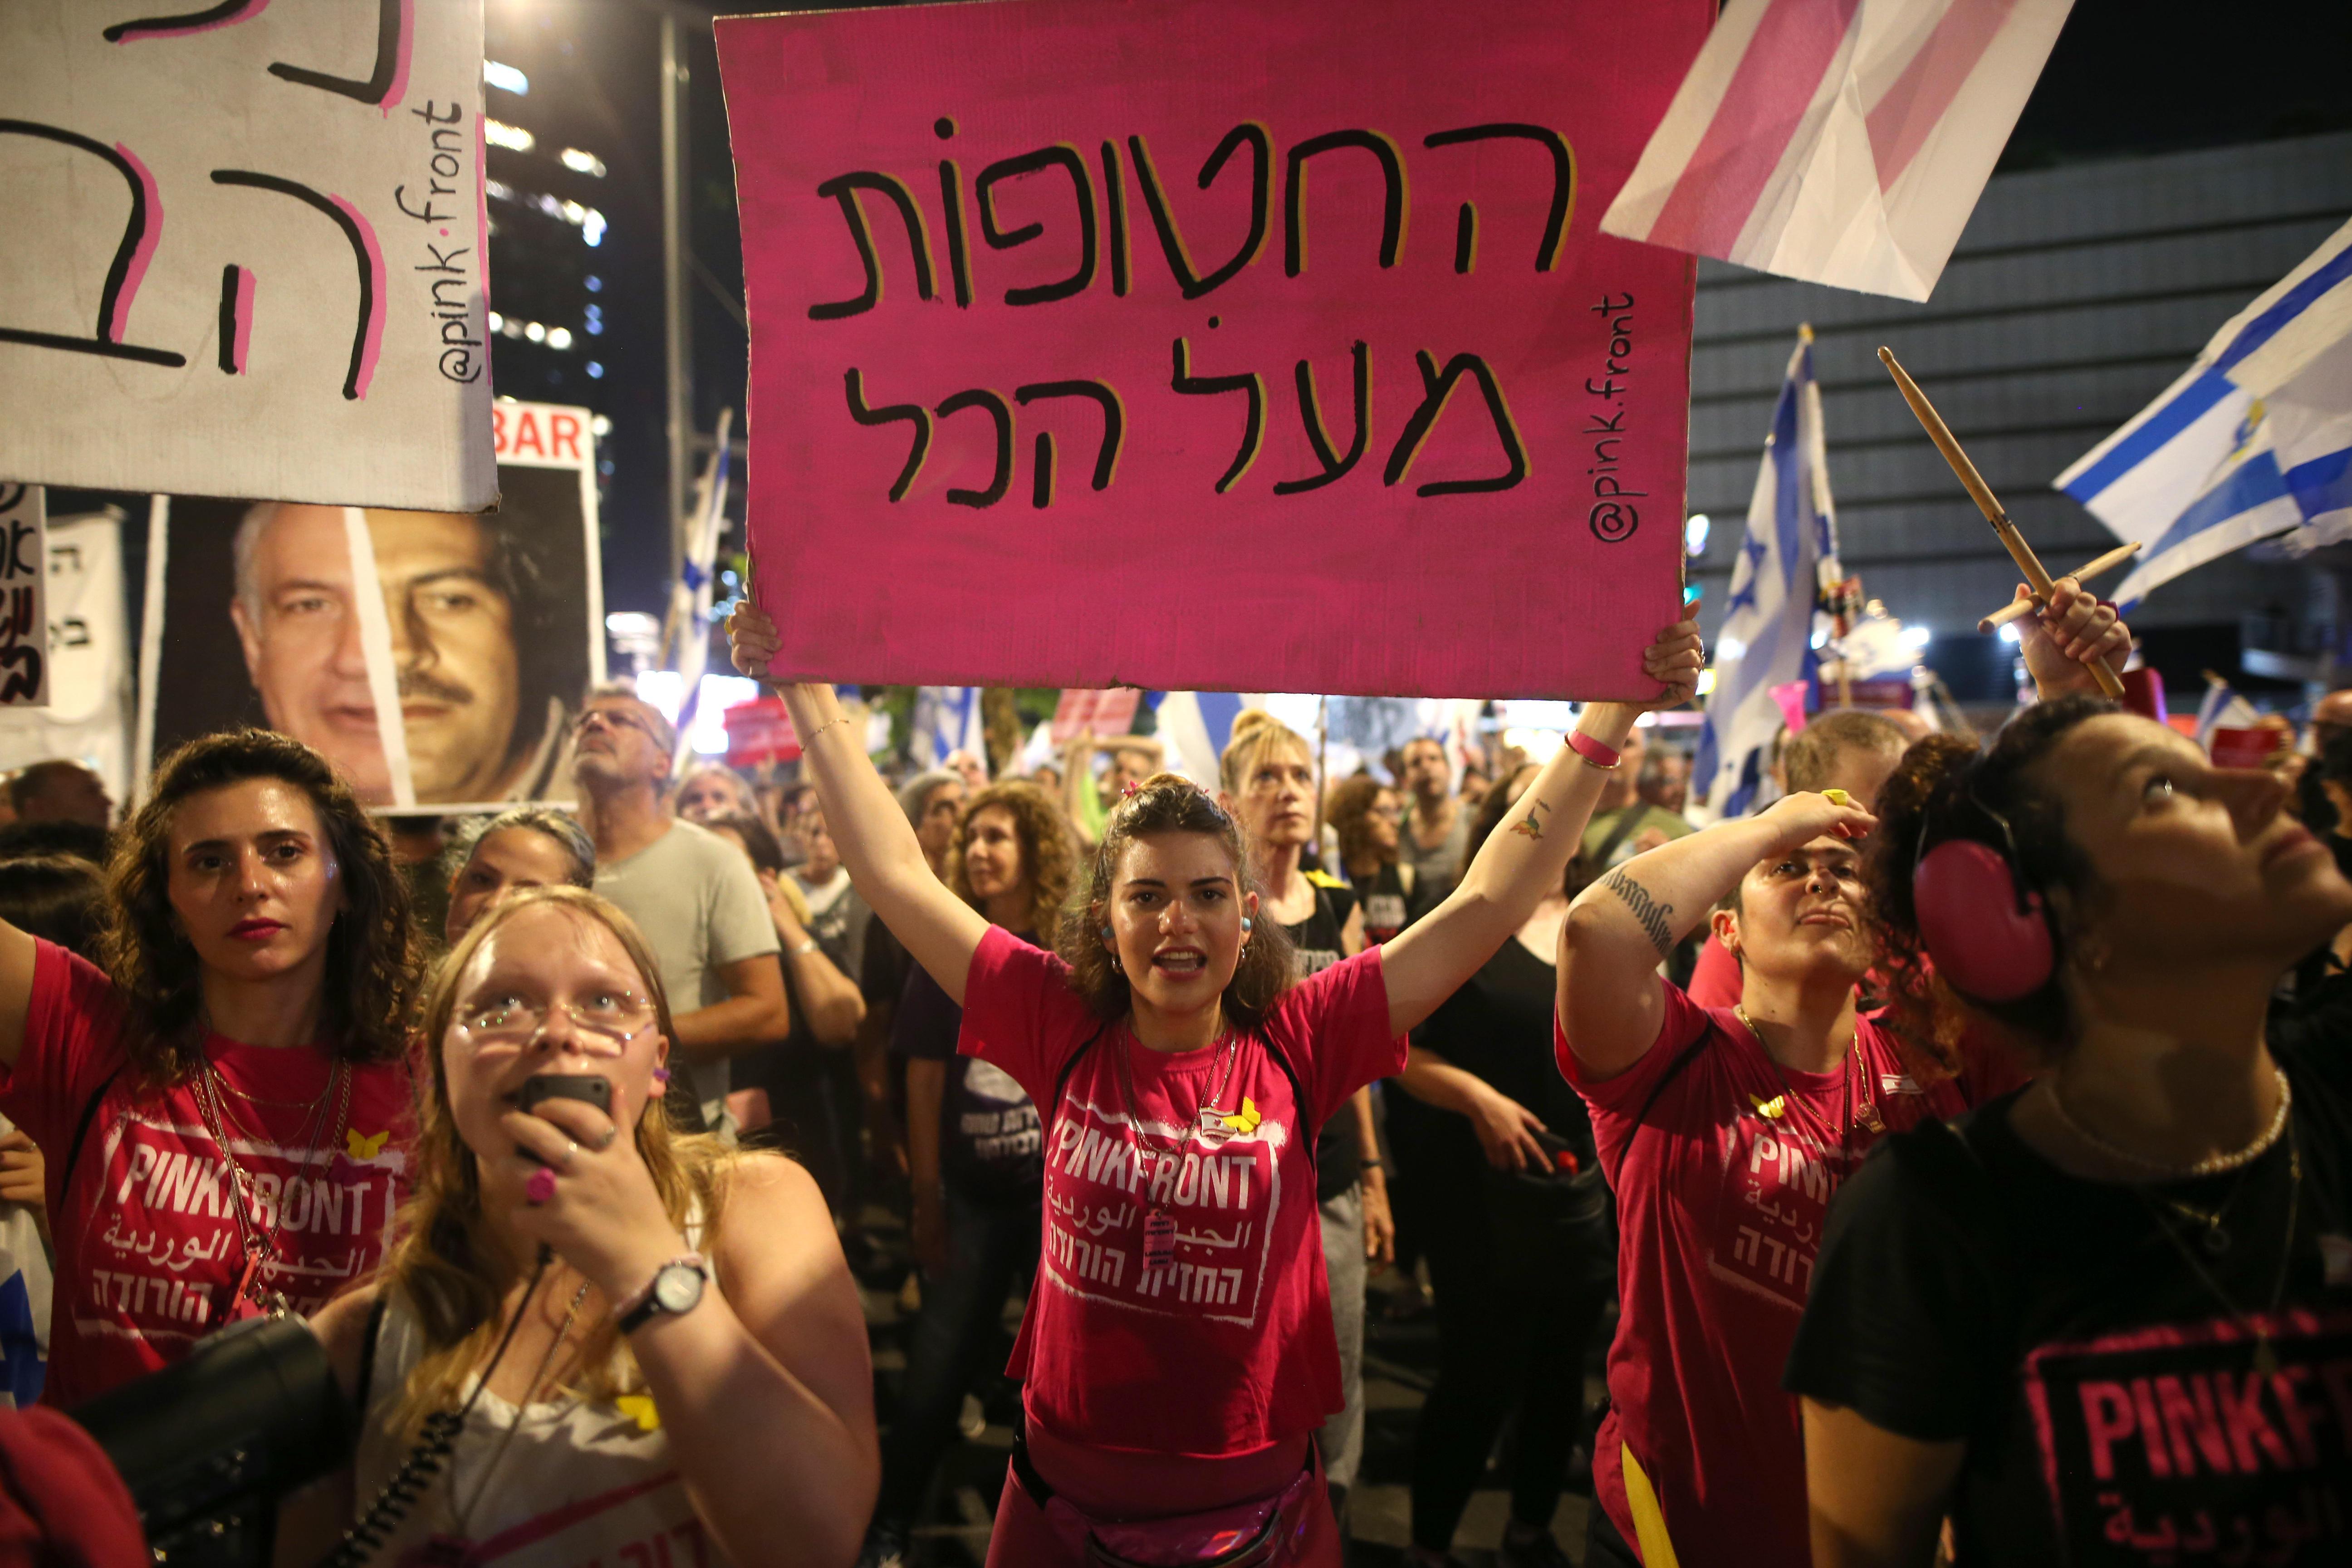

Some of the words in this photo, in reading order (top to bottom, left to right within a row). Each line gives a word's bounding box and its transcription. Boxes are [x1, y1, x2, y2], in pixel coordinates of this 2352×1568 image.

[396, 100, 482, 384] @pink.front
[845, 367, 1125, 509] הכל
[1584, 292, 1648, 544] @pink.front
[117, 1143, 372, 1235] PINKFRONT
[1051, 1118, 1257, 1210] PINKFRONT
[103, 1214, 233, 1270] الوردية
[1049, 1220, 1125, 1288] הורודה
[93, 1270, 213, 1324] הורודה
